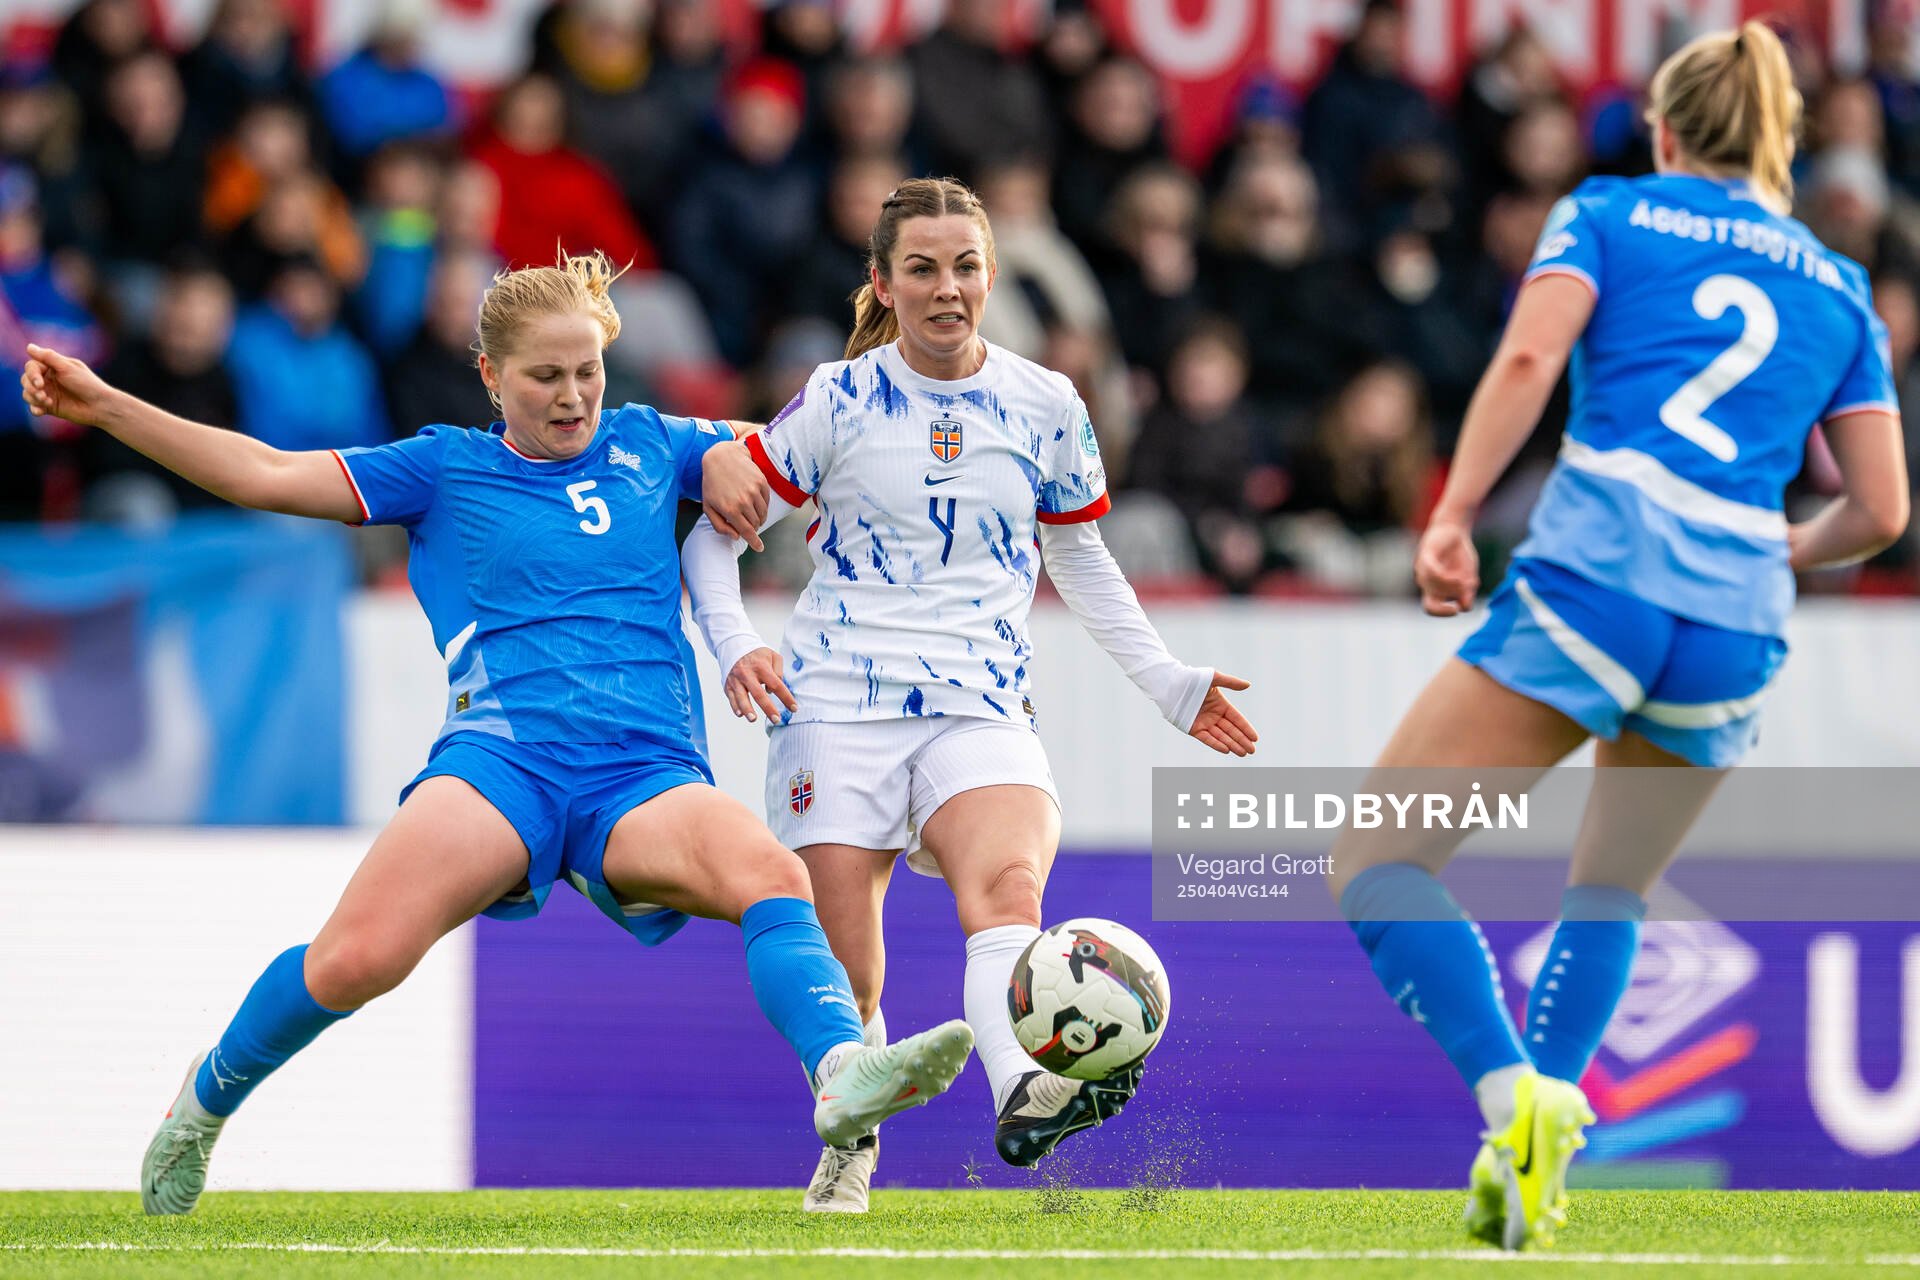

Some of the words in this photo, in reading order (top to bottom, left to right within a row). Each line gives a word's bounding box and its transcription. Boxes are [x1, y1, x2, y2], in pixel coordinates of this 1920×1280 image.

[1659, 273, 1779, 463] 2
[566, 480, 611, 534] 5
[928, 496, 957, 567] 4
